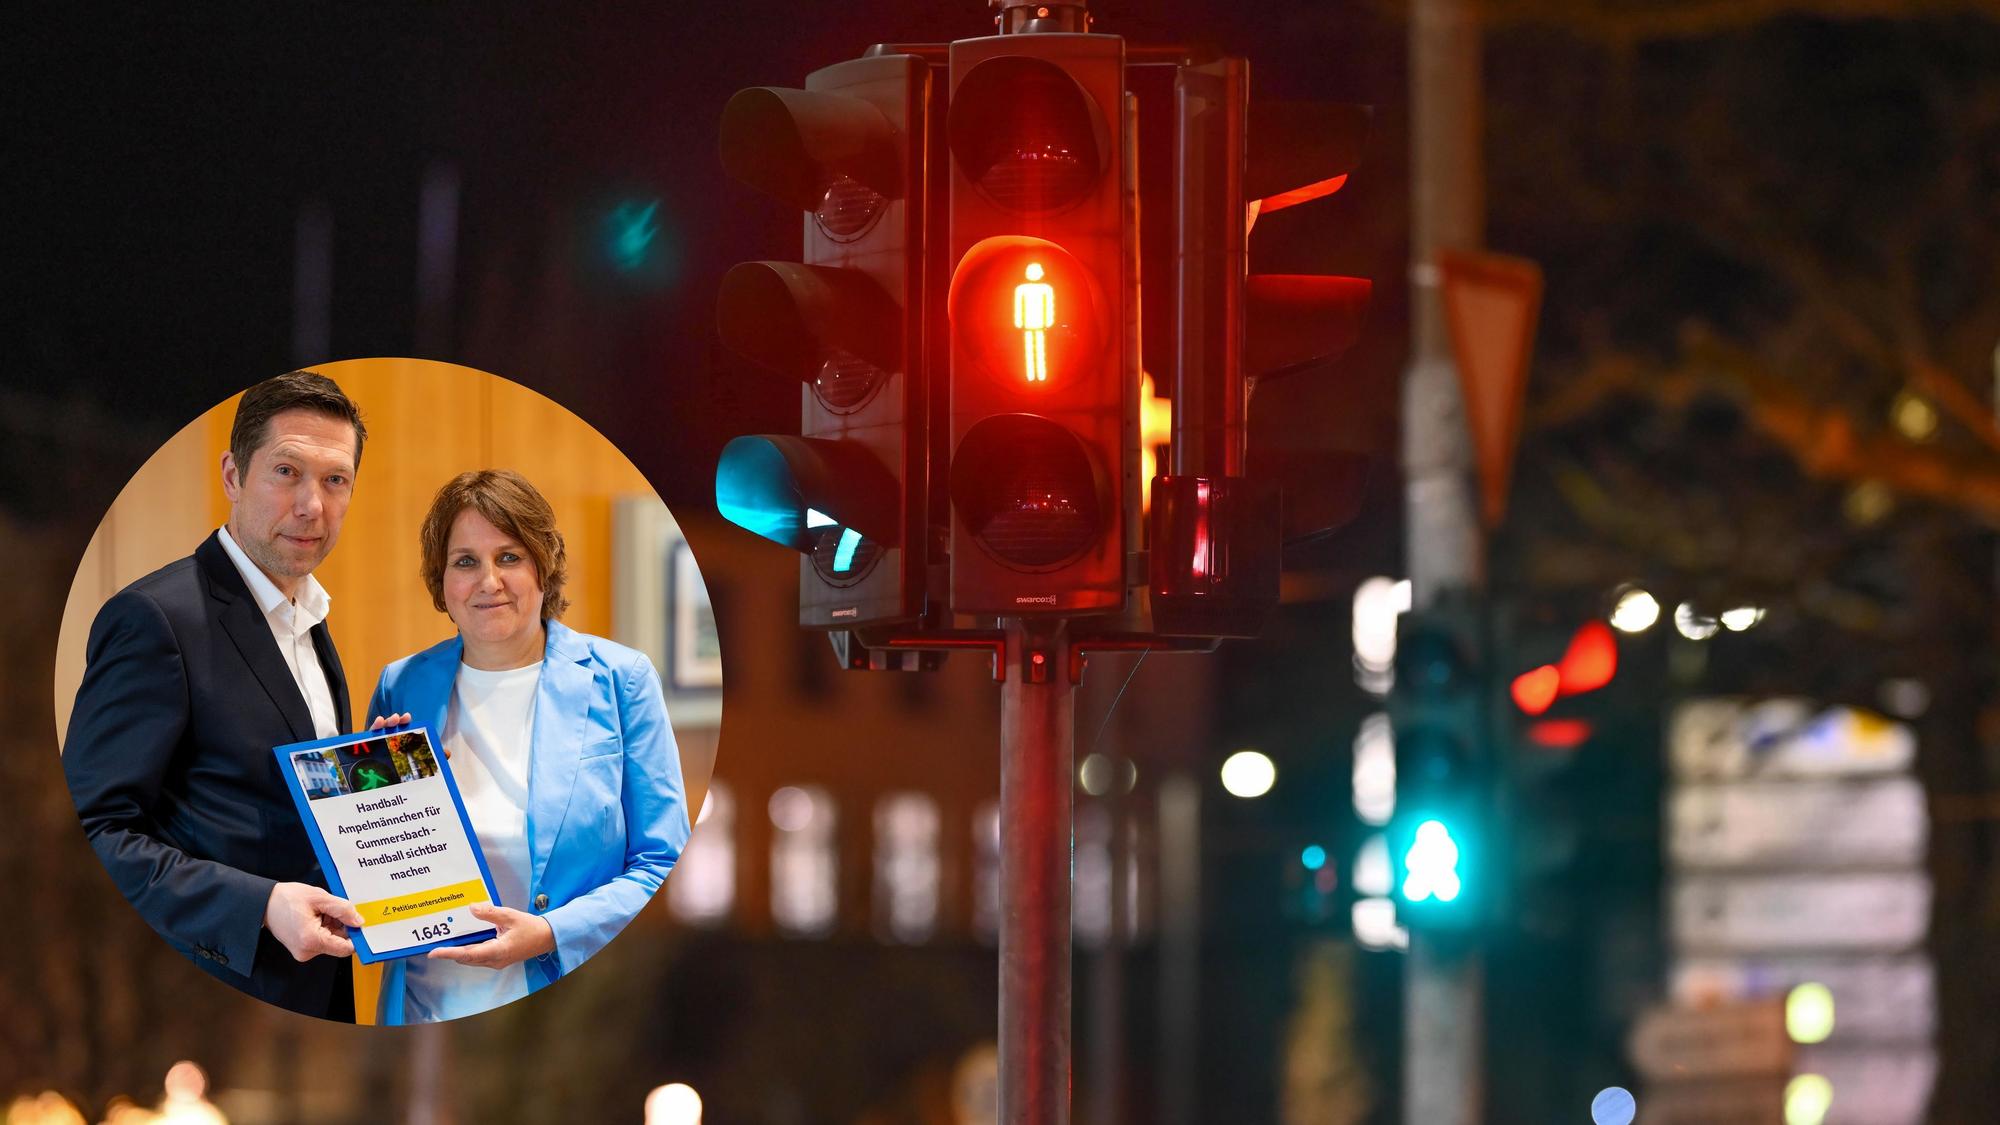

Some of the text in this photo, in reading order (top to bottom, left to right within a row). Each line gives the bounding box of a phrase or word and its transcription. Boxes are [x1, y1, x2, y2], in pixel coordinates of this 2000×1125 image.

[356, 795, 408, 813] Handball-
[338, 806, 441, 835] Ampelmännchen für
[355, 826, 431, 850] Gummersbach
[357, 842, 448, 868] Handball sichtbar
[390, 865, 431, 881] machen
[392, 892, 465, 913] Petition unterschreiben
[411, 922, 451, 942] 1.643
